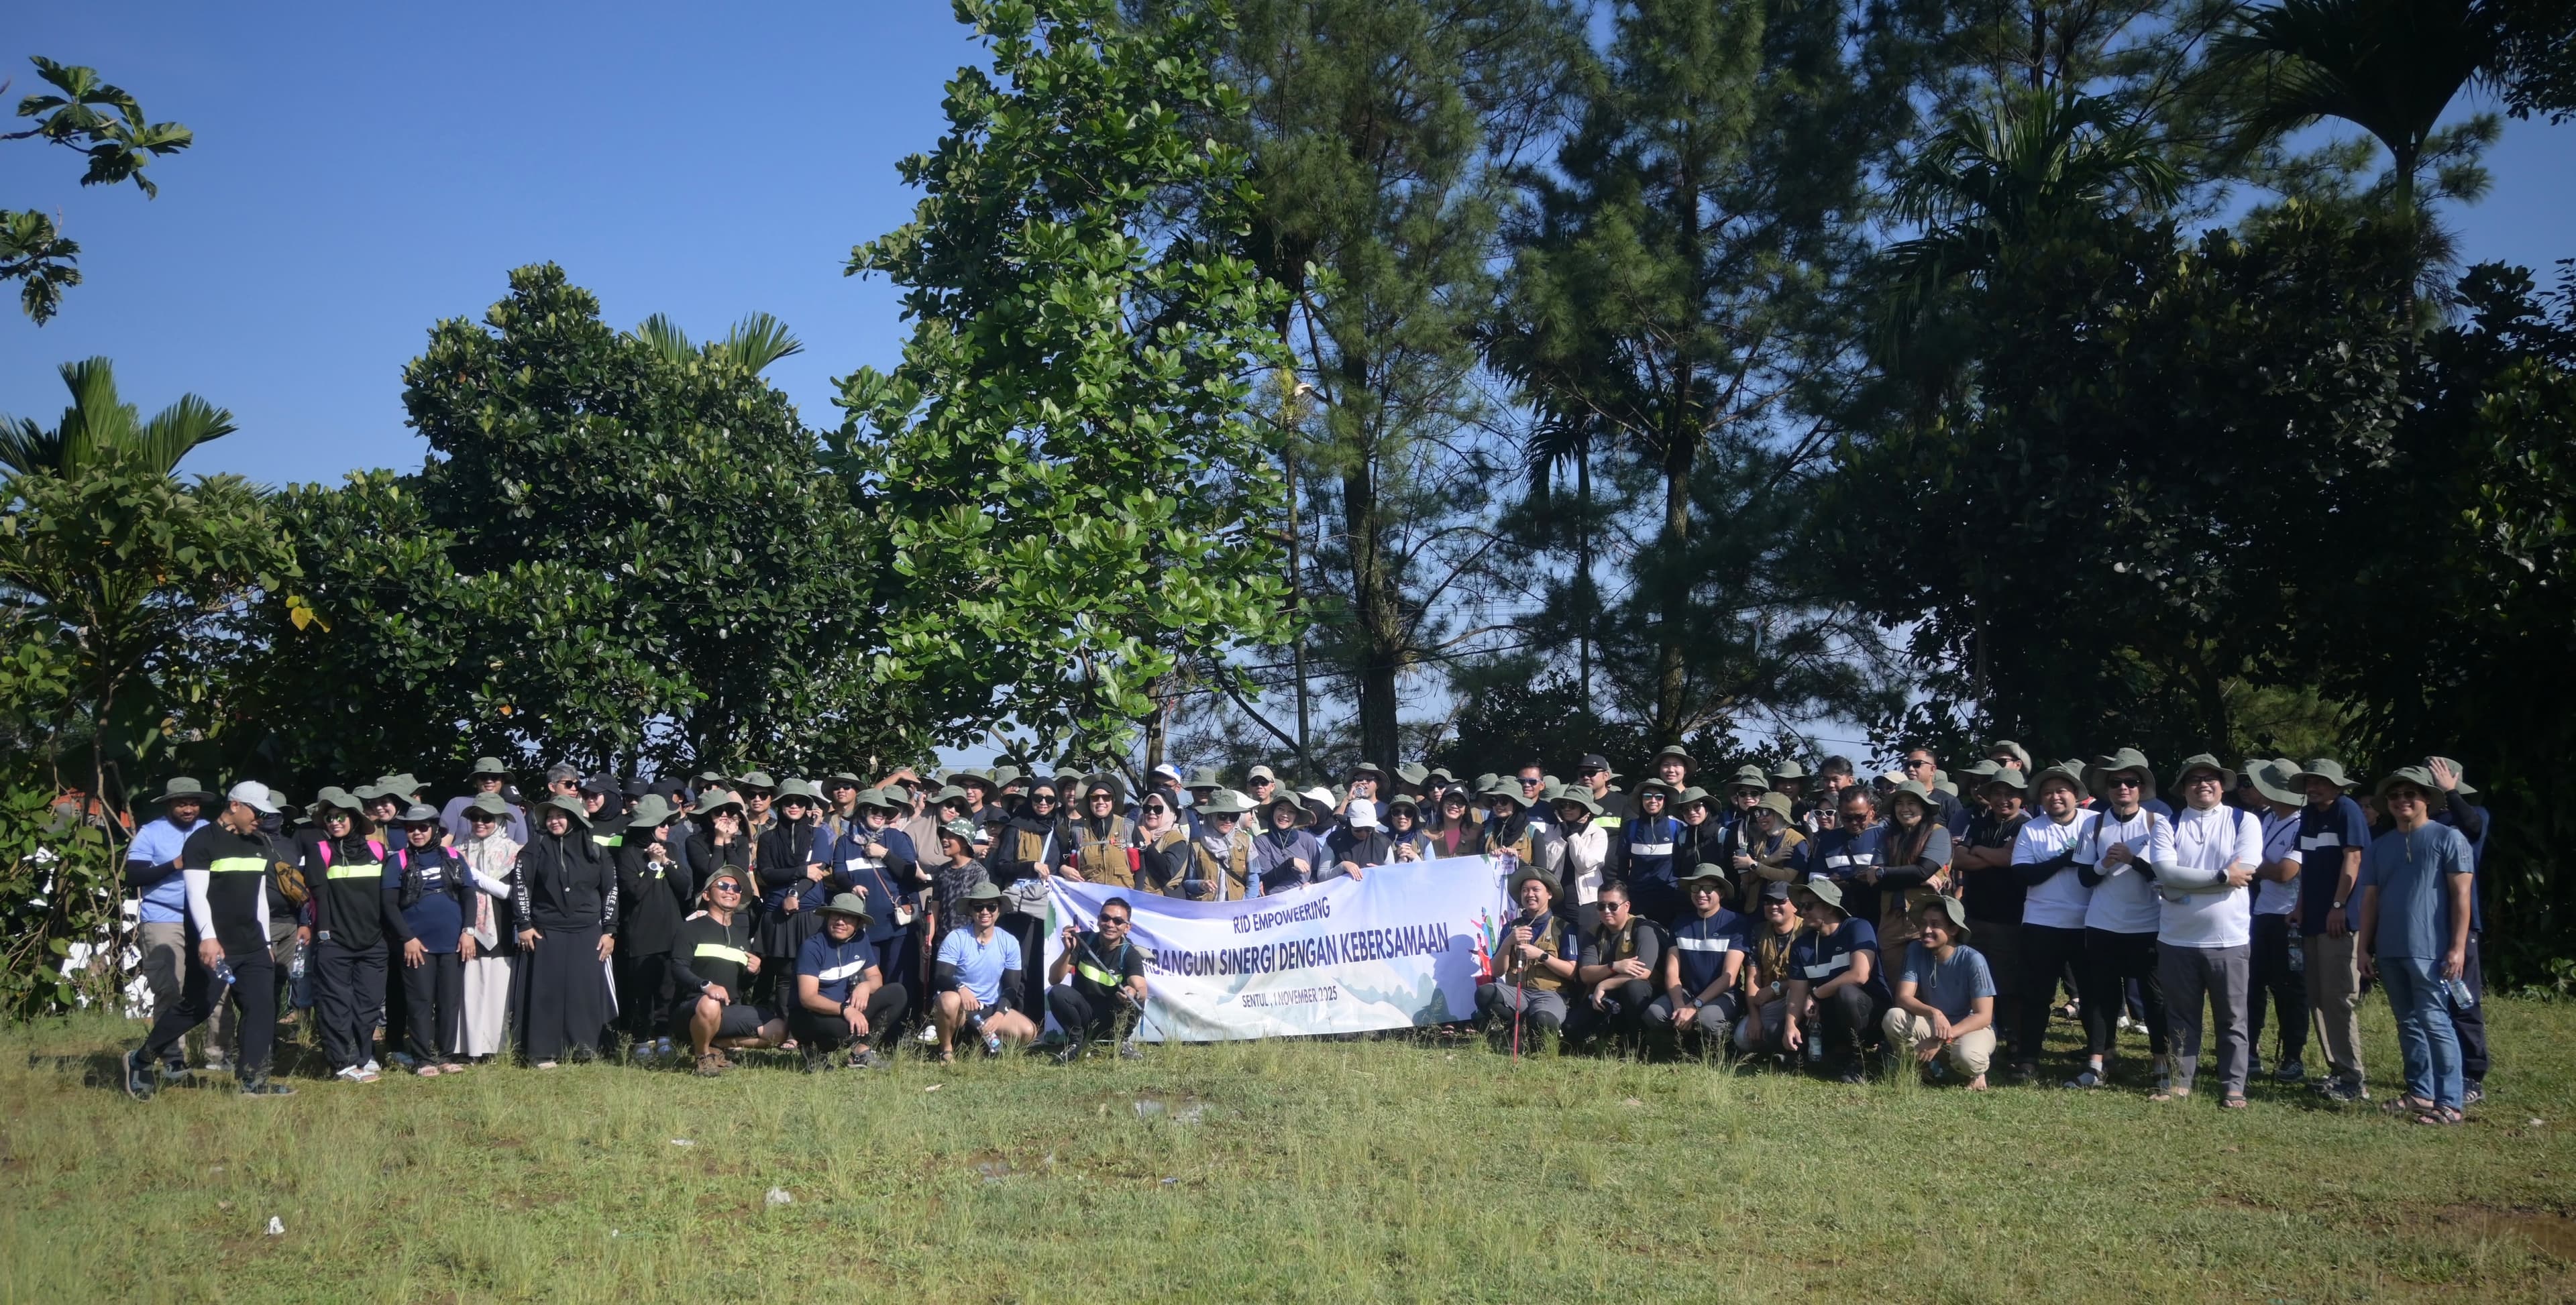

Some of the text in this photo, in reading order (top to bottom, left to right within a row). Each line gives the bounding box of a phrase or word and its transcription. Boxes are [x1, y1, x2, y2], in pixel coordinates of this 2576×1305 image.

[1234, 897, 1330, 933] RID EMPOWEERING
[1219, 944, 1275, 975] SINERGI
[1279, 935, 1338, 971] DENGAN
[1340, 922, 1450, 963] KEBERSAMAAN
[1277, 988, 1318, 1006] NOVEMBER
[1318, 986, 1338, 1002] 2025
